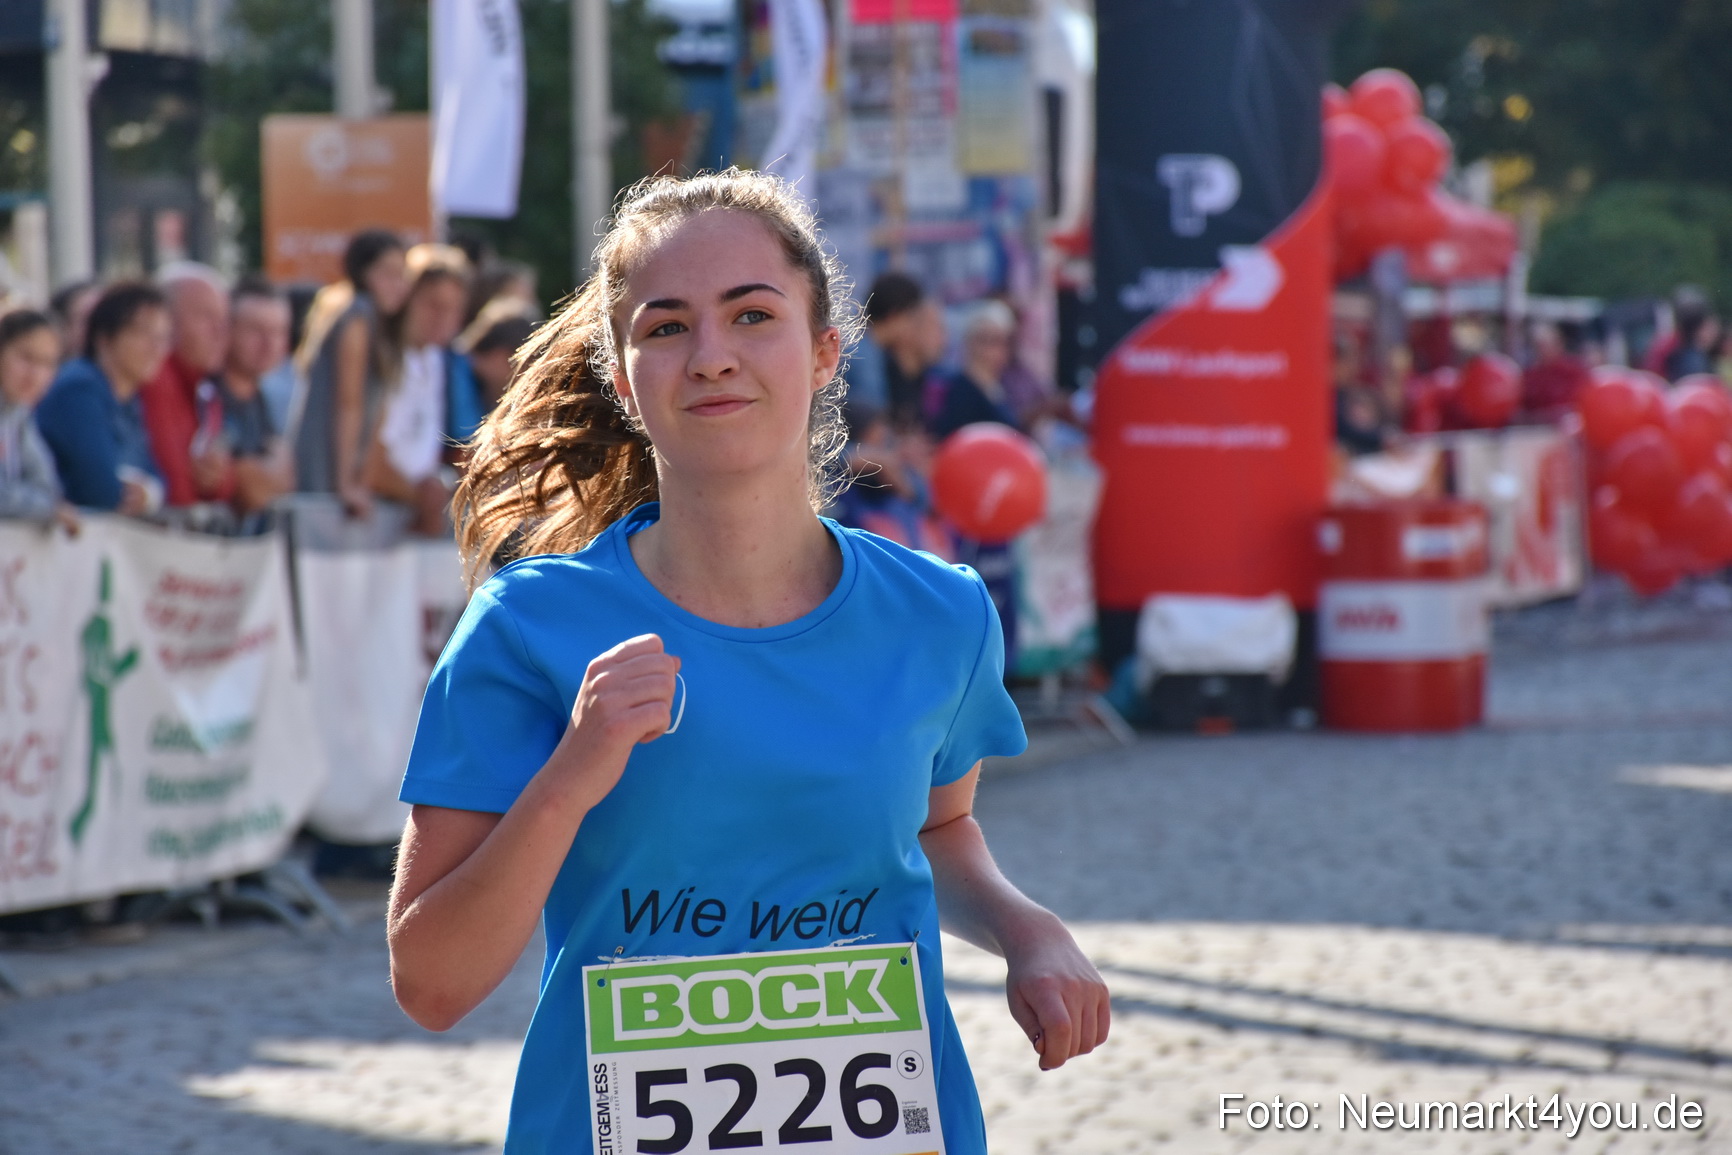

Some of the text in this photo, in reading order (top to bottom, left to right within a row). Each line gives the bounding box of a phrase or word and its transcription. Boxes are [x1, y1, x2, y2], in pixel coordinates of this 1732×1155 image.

[622, 886, 880, 942] Wie weid
[615, 963, 892, 1036] BOCK
[612, 1061, 620, 1111] ZEITMESSUNG
[904, 1056, 917, 1073] S
[635, 1052, 899, 1155] 5226
